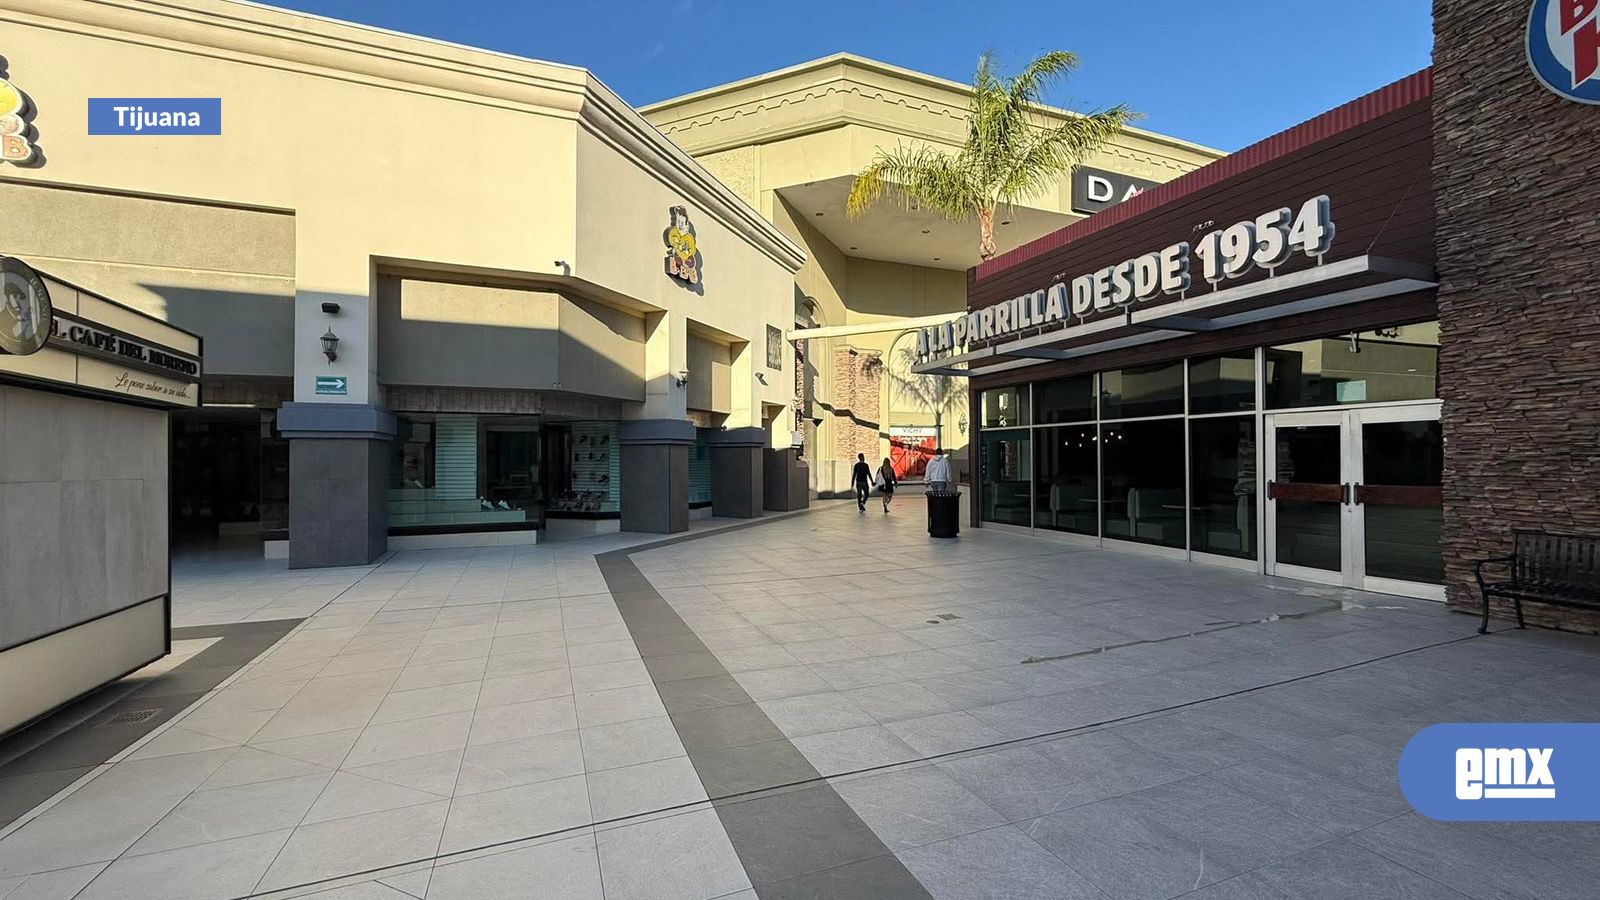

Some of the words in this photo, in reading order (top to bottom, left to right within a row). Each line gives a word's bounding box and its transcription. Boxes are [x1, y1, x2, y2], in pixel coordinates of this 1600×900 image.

[916, 328, 928, 355] A
[929, 322, 952, 351] LA
[955, 283, 1066, 346] PARRILLA
[1072, 241, 1186, 315] DESDE
[1195, 197, 1328, 280] 1954
[70, 326, 116, 352] CAFÉ
[118, 340, 147, 361] DEL
[149, 349, 197, 375] MORENO
[115, 370, 129, 387] Le
[127, 379, 145, 392] pone
